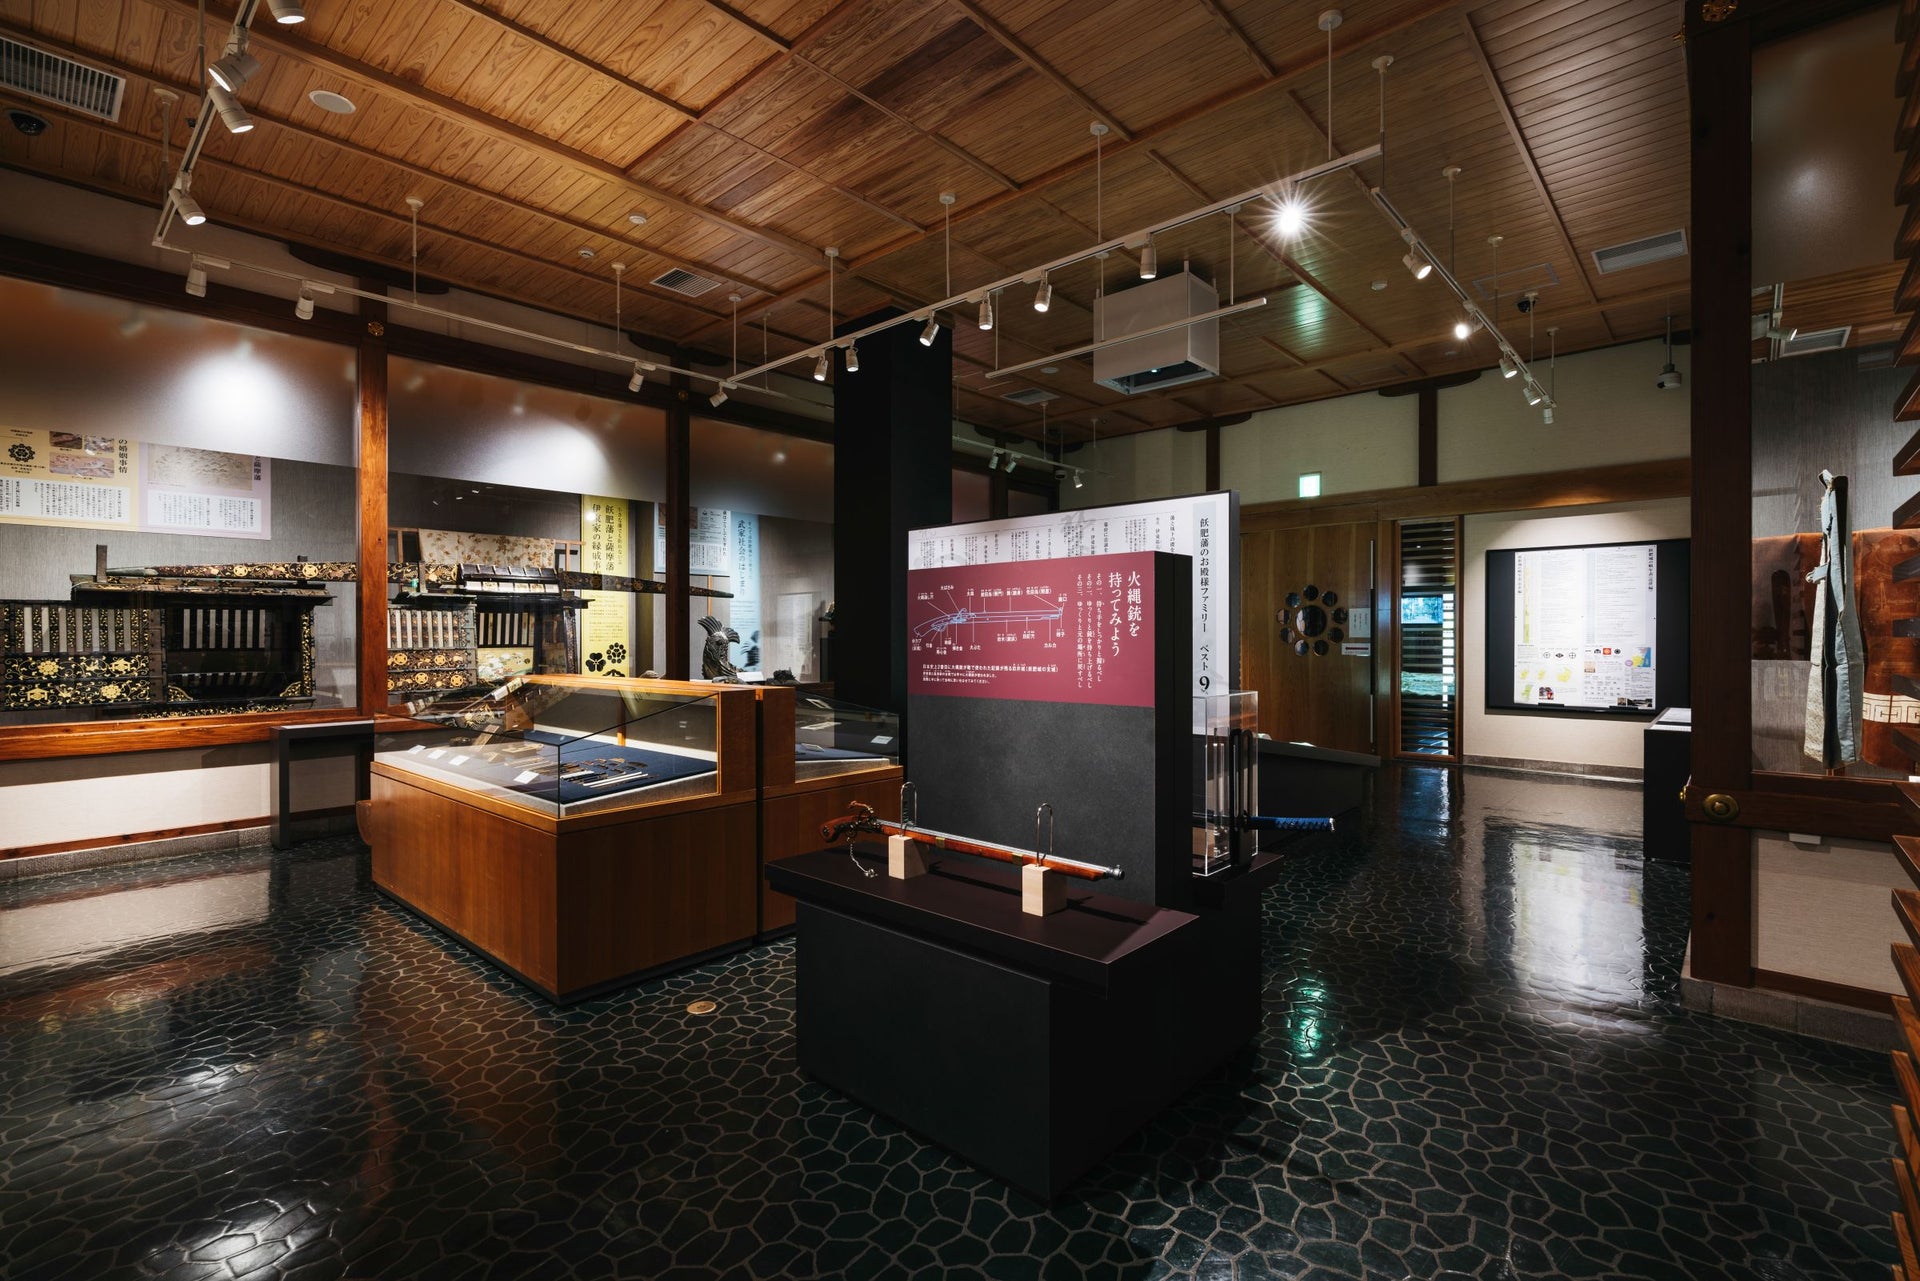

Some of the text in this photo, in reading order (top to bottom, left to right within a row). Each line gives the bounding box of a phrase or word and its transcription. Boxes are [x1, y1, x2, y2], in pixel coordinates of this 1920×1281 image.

[1108, 571, 1122, 657] 持ってみよう
[1127, 570, 1142, 637] 火縄銃を
[1199, 517, 1209, 633] 飫肥藩のお殿様ファミリー
